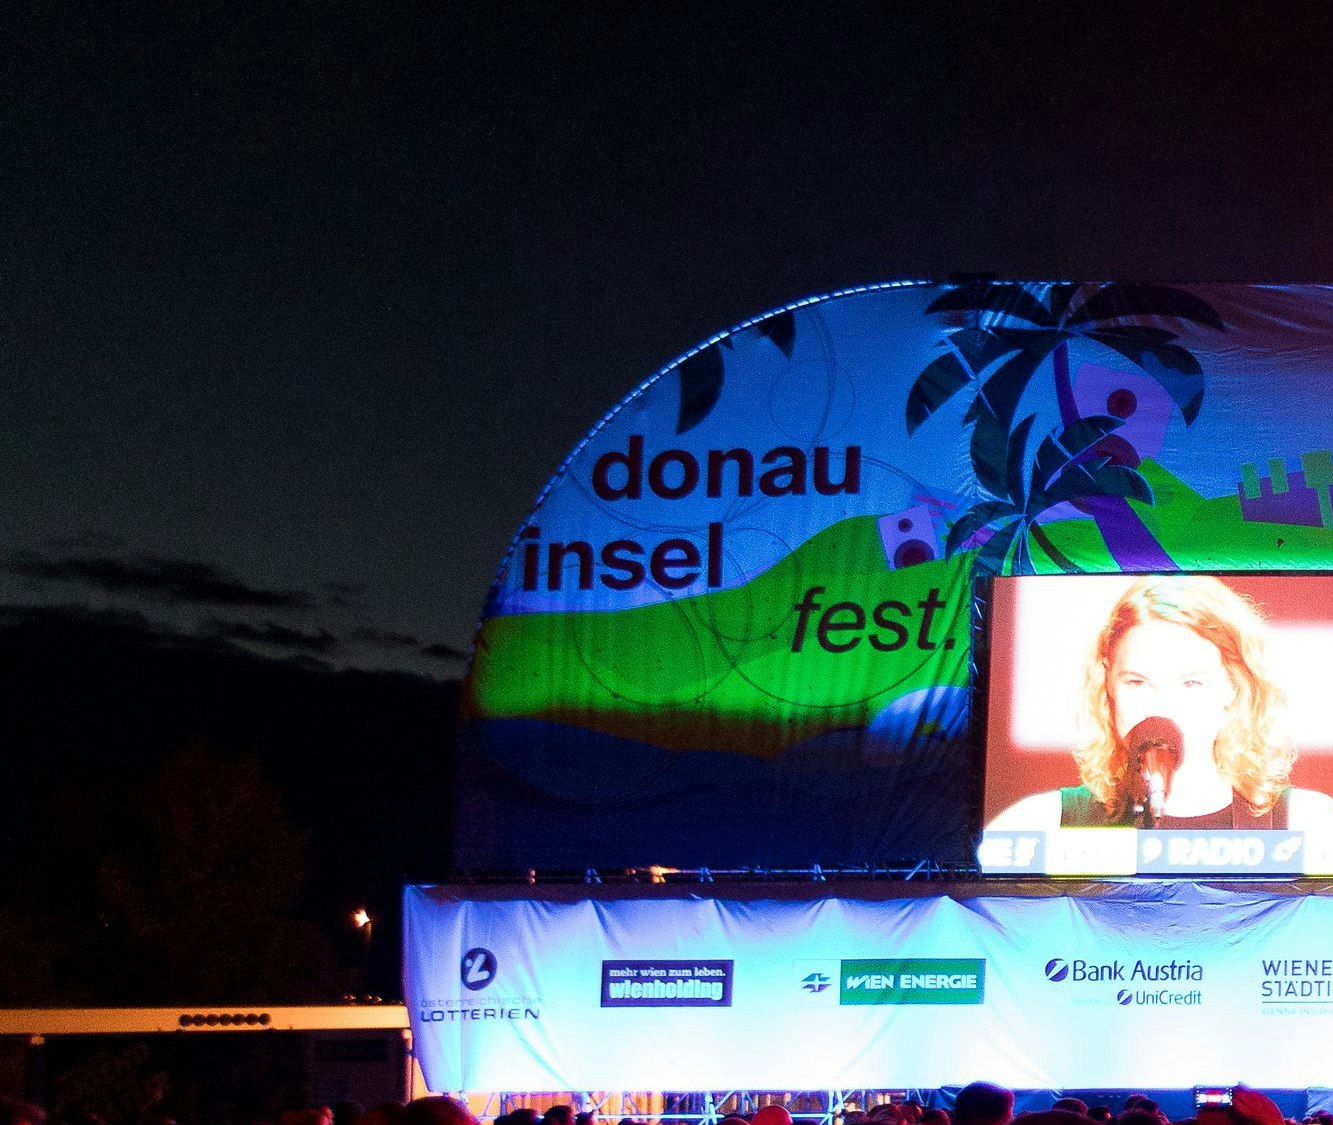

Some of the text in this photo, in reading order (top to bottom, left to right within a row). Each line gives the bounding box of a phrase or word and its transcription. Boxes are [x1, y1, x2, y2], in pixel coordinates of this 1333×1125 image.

[591, 435, 862, 502] donau
[521, 521, 724, 593] insel
[790, 585, 957, 654] fest.
[1167, 836, 1264, 865] RADIO
[609, 967, 726, 977] mehr wien zum leben.
[900, 974, 977, 989] ENERGIE
[1073, 959, 1204, 982] Bank Austria
[609, 979, 723, 1001] wienholding
[1135, 989, 1202, 1006] UniCredit
[421, 1008, 540, 1022] LOTTERIEN
